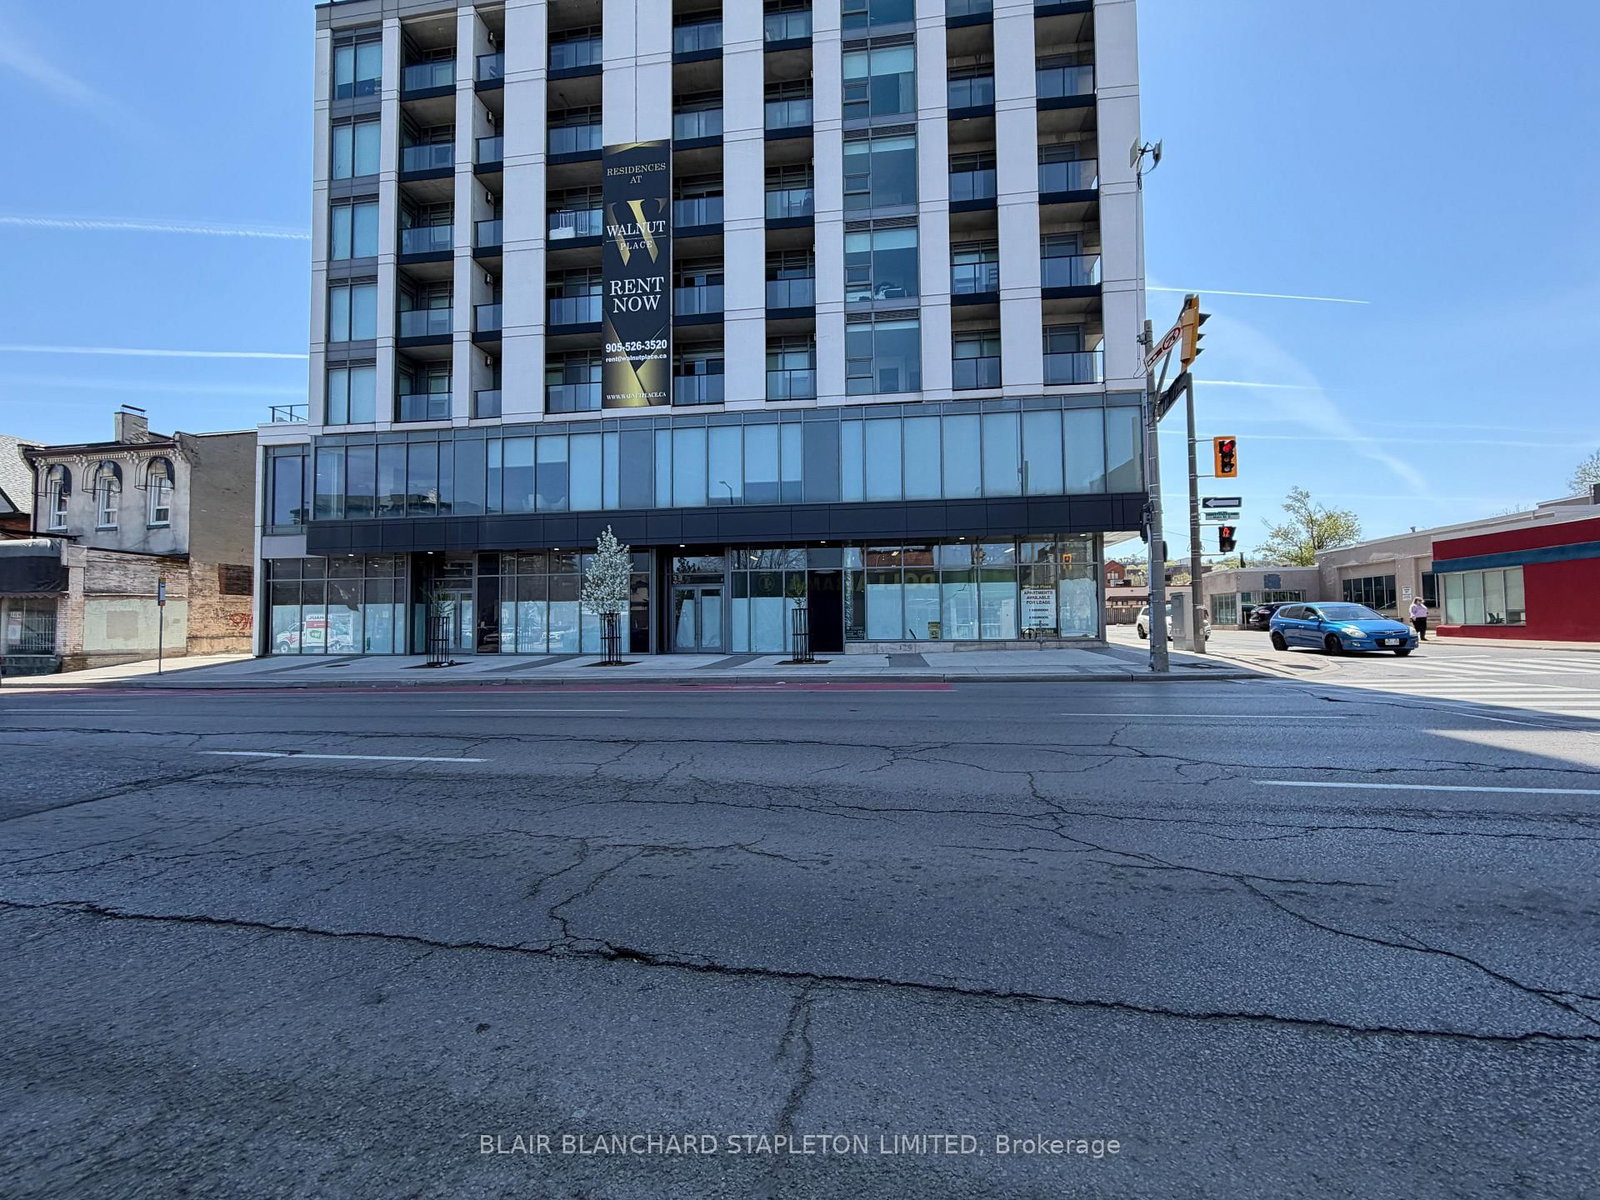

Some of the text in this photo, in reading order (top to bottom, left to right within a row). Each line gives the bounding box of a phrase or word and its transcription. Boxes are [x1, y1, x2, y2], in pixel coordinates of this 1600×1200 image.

[607, 163, 667, 176] RESIDENCES
[630, 175, 643, 184] AT
[606, 221, 666, 237] WALNUT
[620, 241, 653, 251] PLACE
[609, 277, 665, 296] RENT
[612, 295, 662, 313] NOW
[606, 340, 668, 353] 905-526-3520
[605, 354, 668, 363] rent@walnutplace.ca
